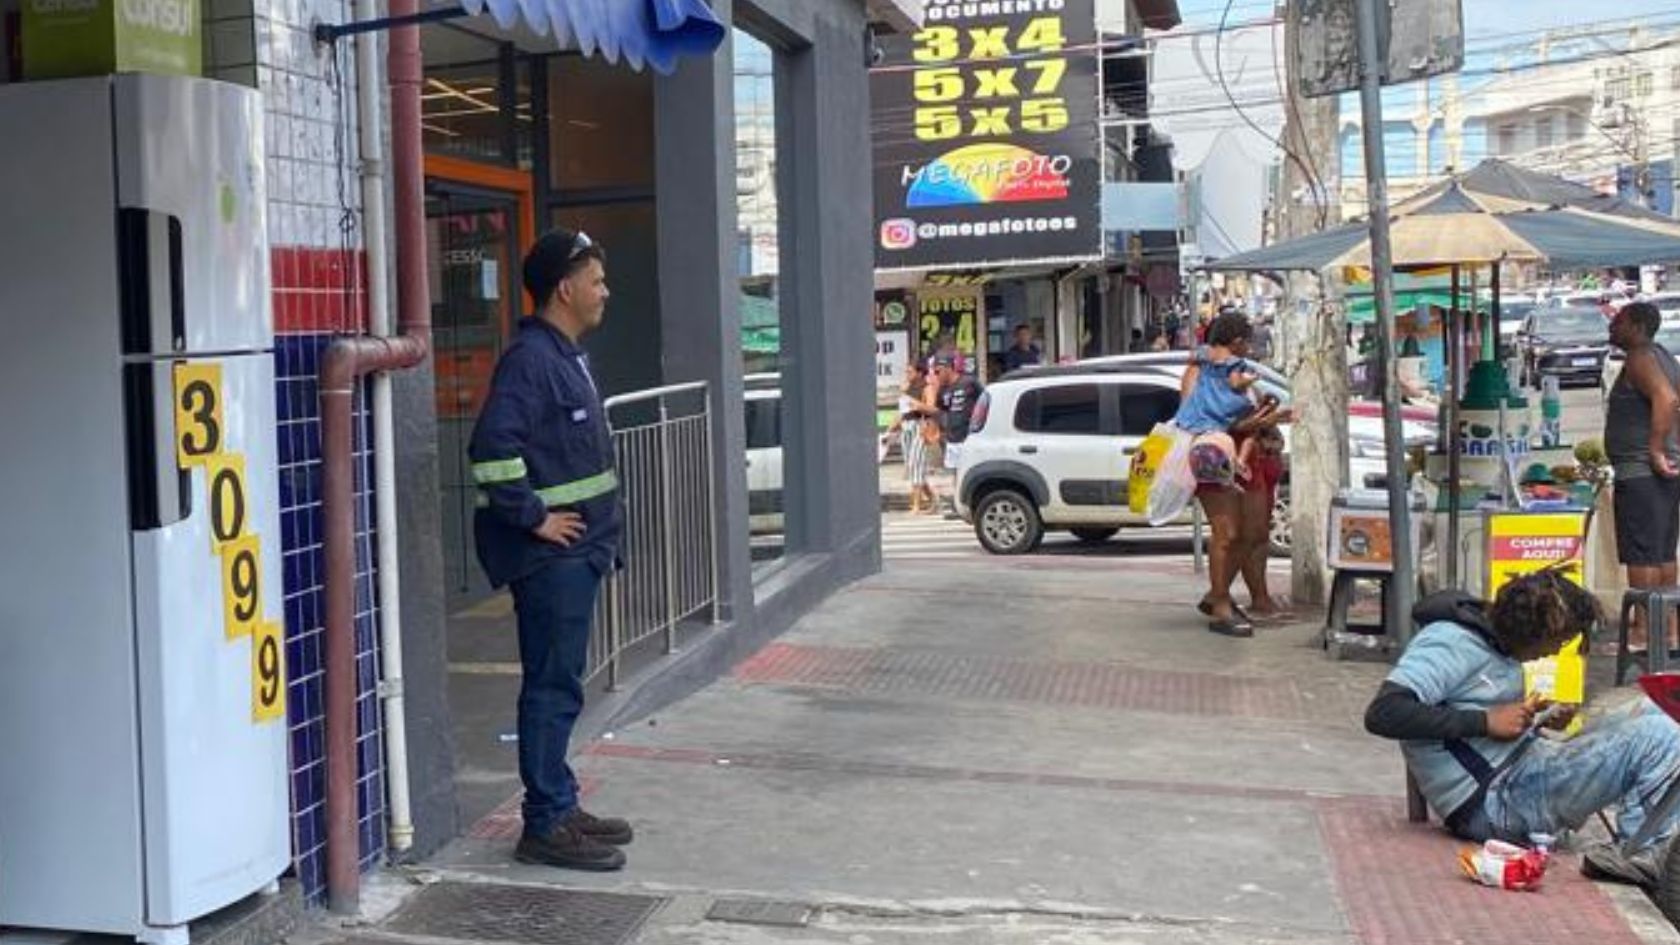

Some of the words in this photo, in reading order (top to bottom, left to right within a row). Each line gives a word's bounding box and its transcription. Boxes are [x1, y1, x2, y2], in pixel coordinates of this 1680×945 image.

[922, 0, 1066, 20] OCUMENTO
[901, 154, 1072, 186] MEGAFOTO
[1509, 537, 1575, 549] COMPRE
